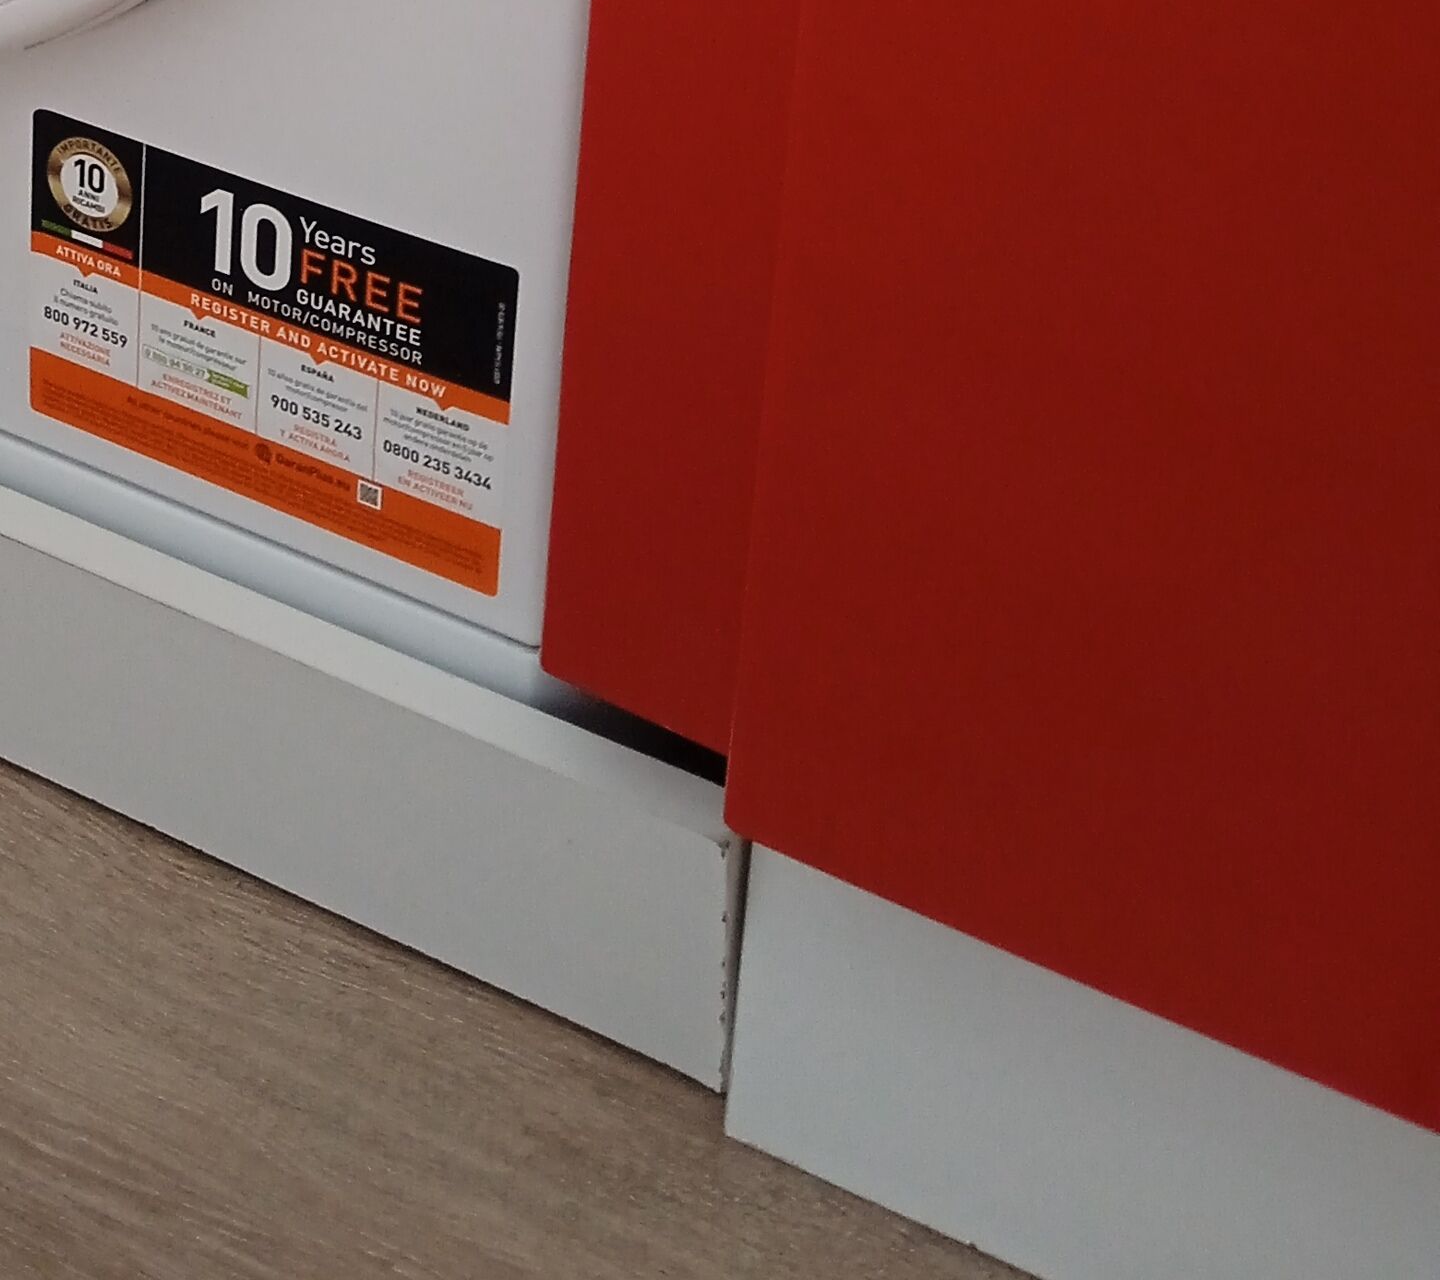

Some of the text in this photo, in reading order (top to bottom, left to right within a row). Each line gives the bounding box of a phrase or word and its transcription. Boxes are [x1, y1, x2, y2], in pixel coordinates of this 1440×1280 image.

[74, 158, 105, 193] 10
[55, 242, 121, 278] ATTIVA ORA
[200, 188, 293, 291] 10
[299, 216, 377, 266] Years
[72, 277, 98, 295] ITALIA
[300, 248, 423, 324] FREE
[43, 304, 69, 327] 800
[72, 315, 98, 339] 972
[101, 326, 128, 350] 559
[211, 278, 235, 296] ON
[247, 291, 423, 366] MOTOR/COMPRESSOR
[296, 289, 422, 347] GUARANTEE
[190, 293, 447, 399] REGISTER AND ACTIVATE NOW
[270, 392, 298, 417] 900
[301, 404, 331, 429] 535
[333, 417, 363, 442] 243
[382, 438, 419, 464] 0800
[421, 452, 451, 476] 235
[453, 464, 492, 491] 3434
